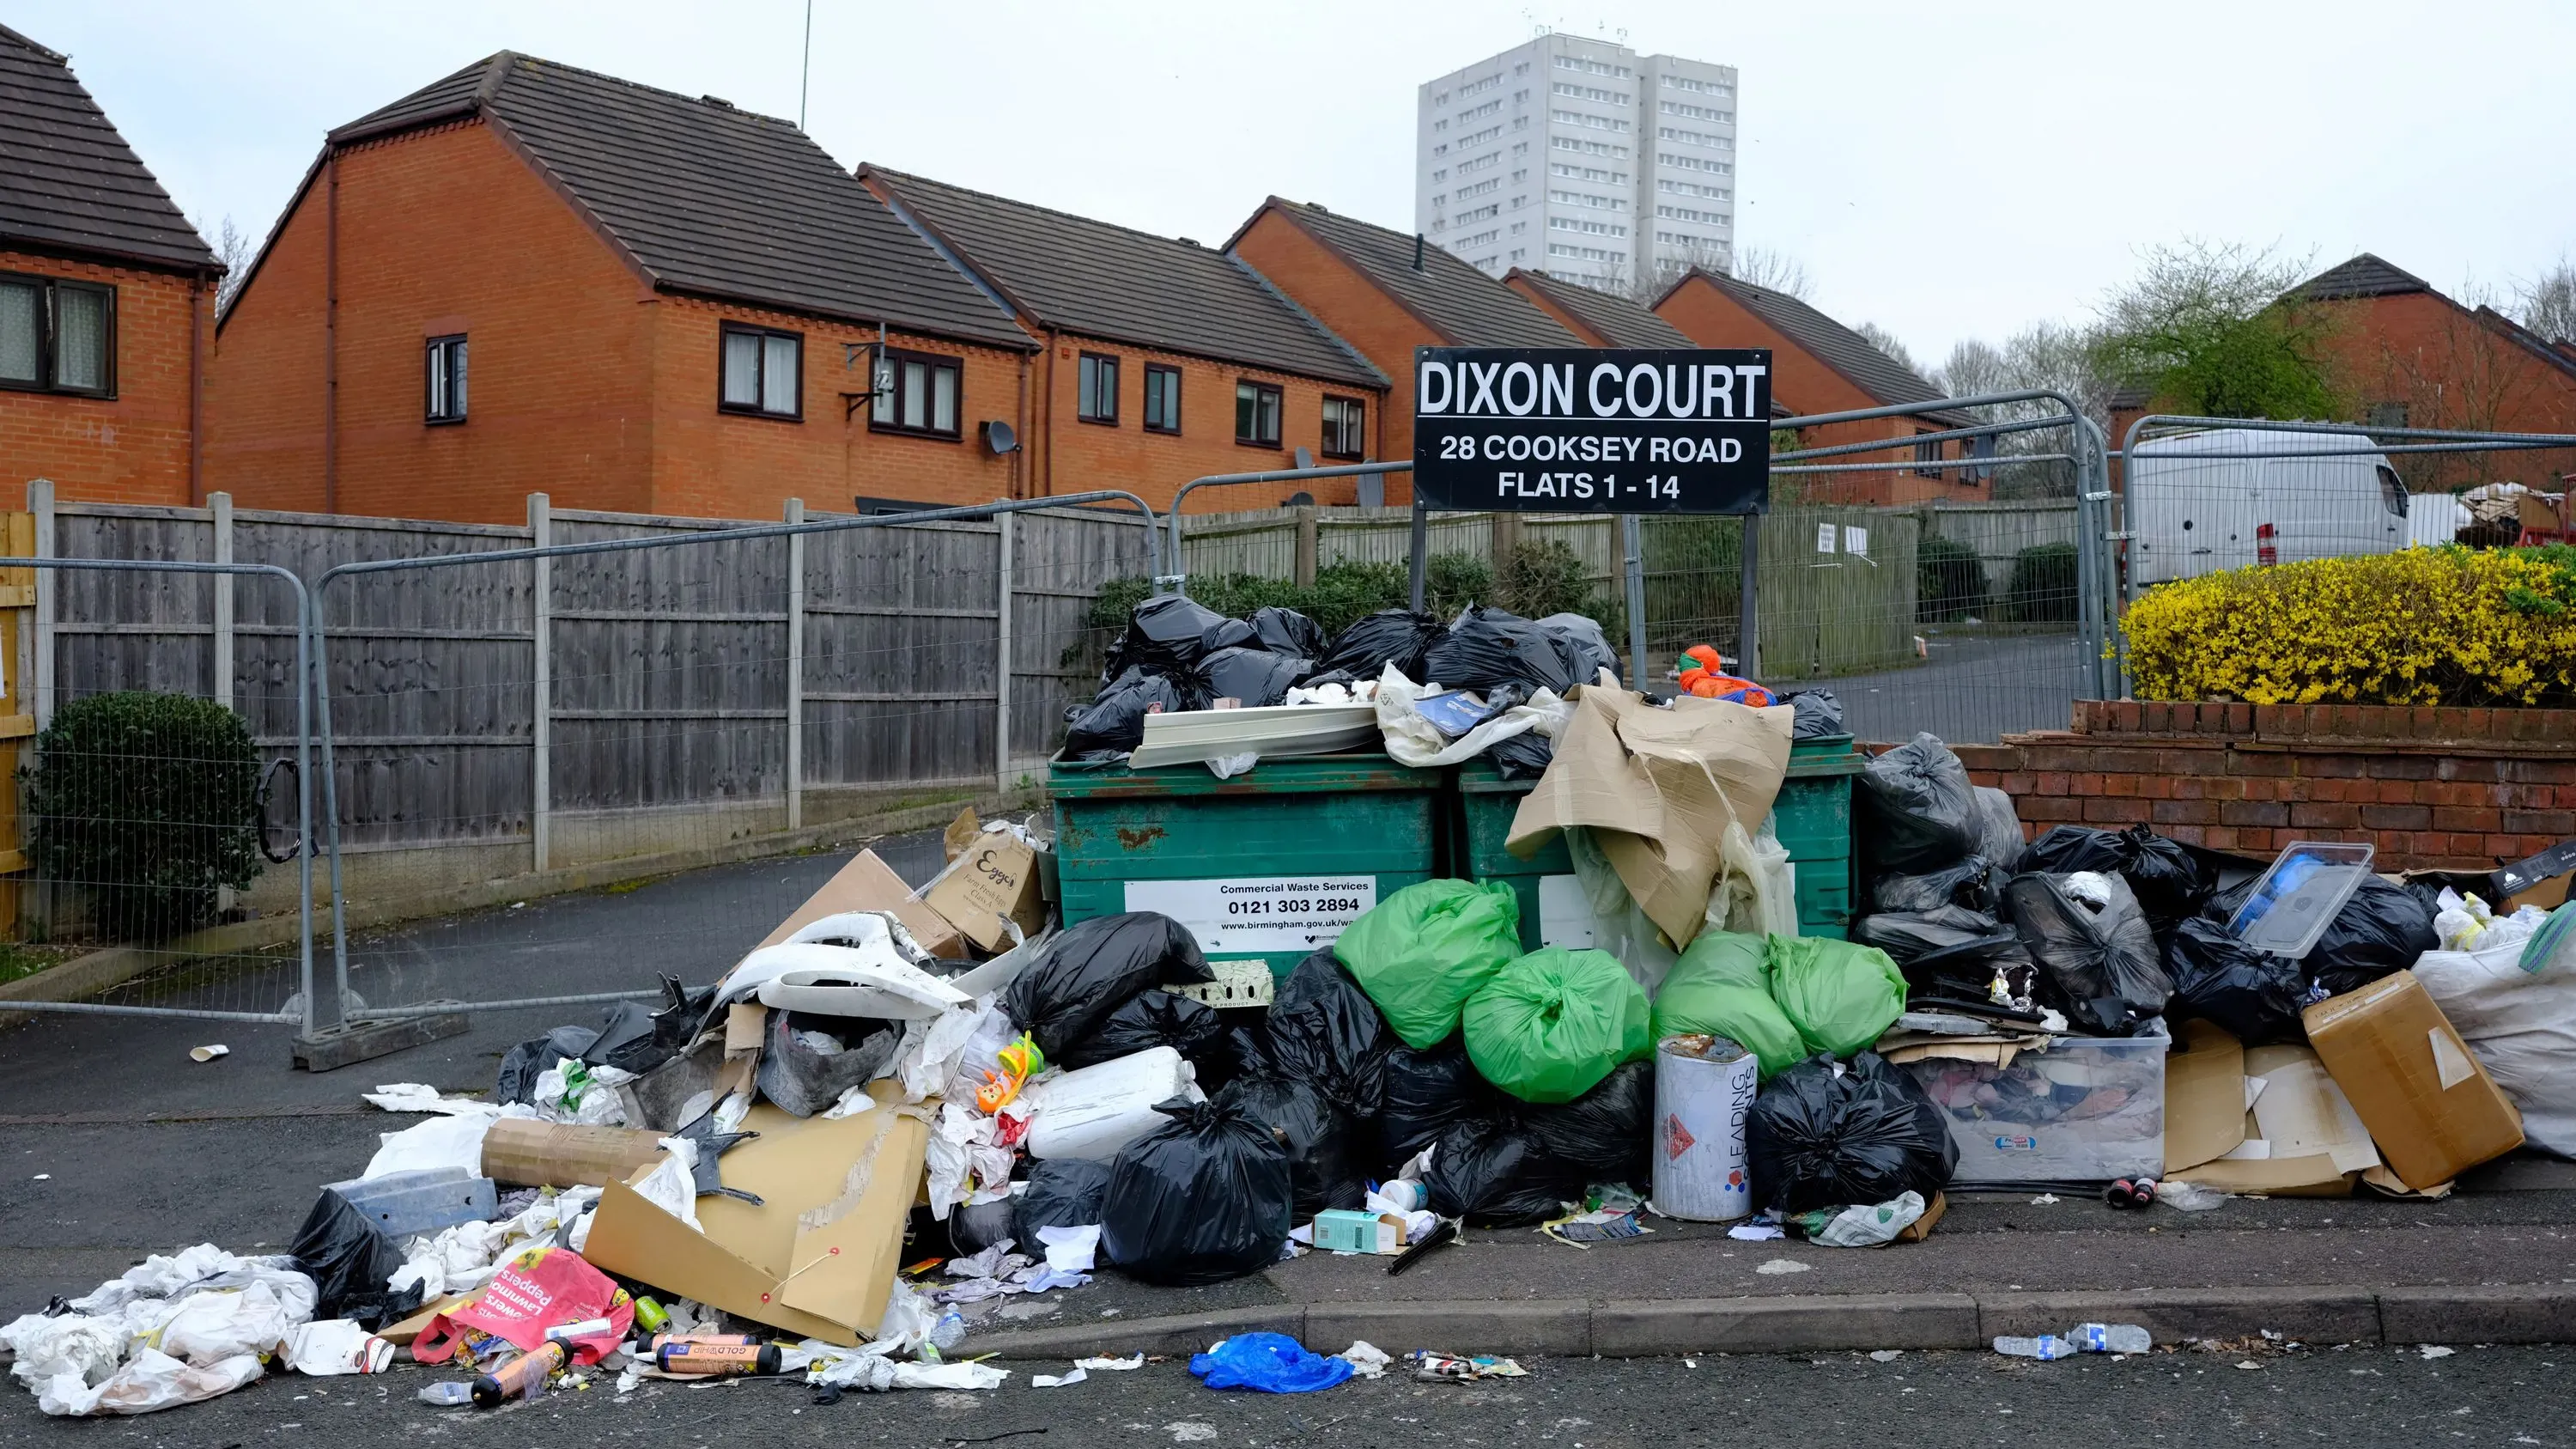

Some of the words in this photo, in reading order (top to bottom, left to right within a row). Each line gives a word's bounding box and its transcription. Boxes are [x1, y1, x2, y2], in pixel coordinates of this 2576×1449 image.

[1419, 362, 1574, 416] DIXON
[1588, 363, 1766, 418] COURT
[1440, 435, 1476, 460] 28
[1483, 435, 1643, 462] COOKSEY
[1649, 437, 1742, 463] ROAD
[1498, 472, 1595, 498] FLATS
[1604, 474, 1615, 498] 1
[1645, 475, 1680, 499] 14
[963, 873, 979, 890] Farm
[979, 883, 995, 900] Fresh
[970, 889, 987, 904] Class
[1220, 883, 1284, 894] Commercial
[1287, 883, 1320, 892] Waste
[1322, 882, 1369, 891] Services
[1229, 901, 1271, 915] 0121
[1278, 899, 1310, 913] 303
[1316, 898, 1359, 912] 2894
[1221, 920, 1354, 931] www.birmingham.gov.uk/wa
[1730, 1074, 1746, 1169] LEADING
[489, 1280, 544, 1316] Lawnmo
